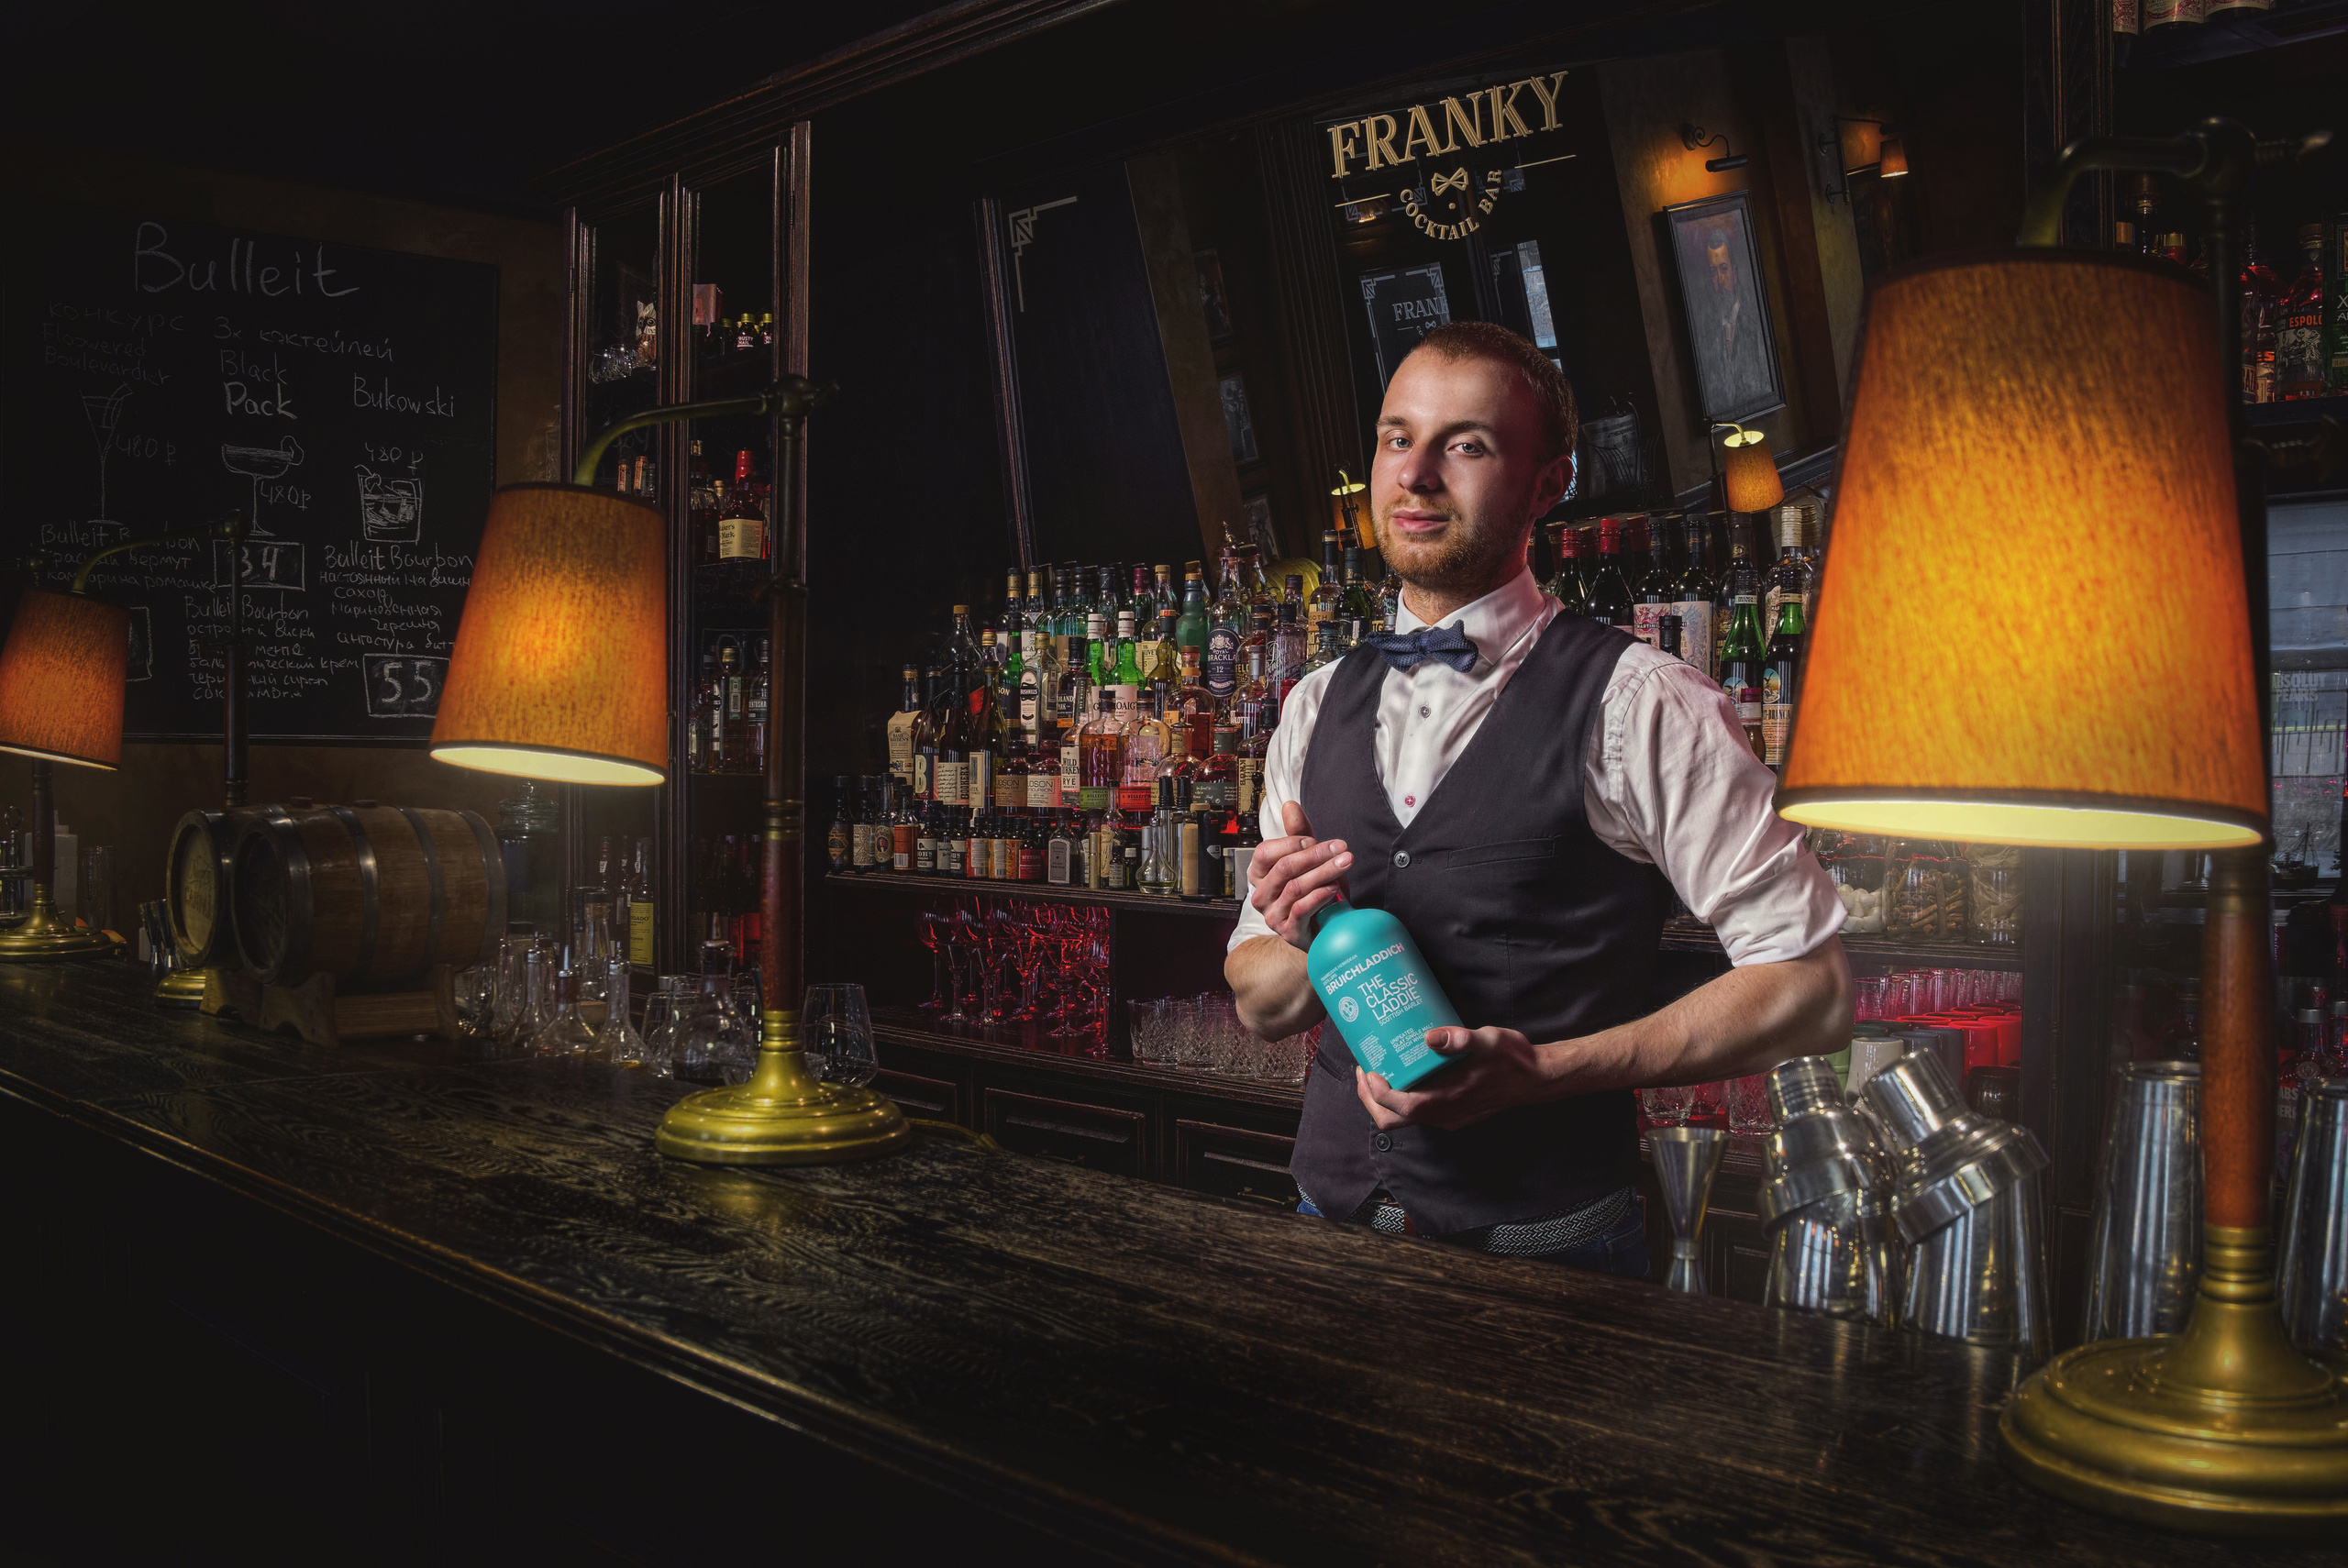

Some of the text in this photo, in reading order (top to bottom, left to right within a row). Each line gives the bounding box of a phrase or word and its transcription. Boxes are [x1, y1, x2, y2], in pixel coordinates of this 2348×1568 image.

[1327, 71, 1569, 178] FRANKY
[1400, 169, 1502, 240] COCKTAIL BAR
[135, 221, 360, 297] Bulleit
[1392, 295, 1450, 321] FRANK
[220, 348, 288, 385] Black
[223, 381, 297, 420] Pack
[354, 373, 454, 416] Bukowski
[116, 434, 158, 458] 480
[40, 519, 110, 547] Bulleit
[324, 540, 474, 571] Bulleit Bourbon
[184, 590, 309, 621] Bullei Bourbon
[1325, 943, 1405, 995] BRUICHLADDICH
[1357, 973, 1387, 996] THE
[1366, 973, 1418, 1008] CLASSIC
[1372, 987, 1421, 1021] LADDIE
[1379, 998, 1423, 1026] SCOTTISH BARLEY
